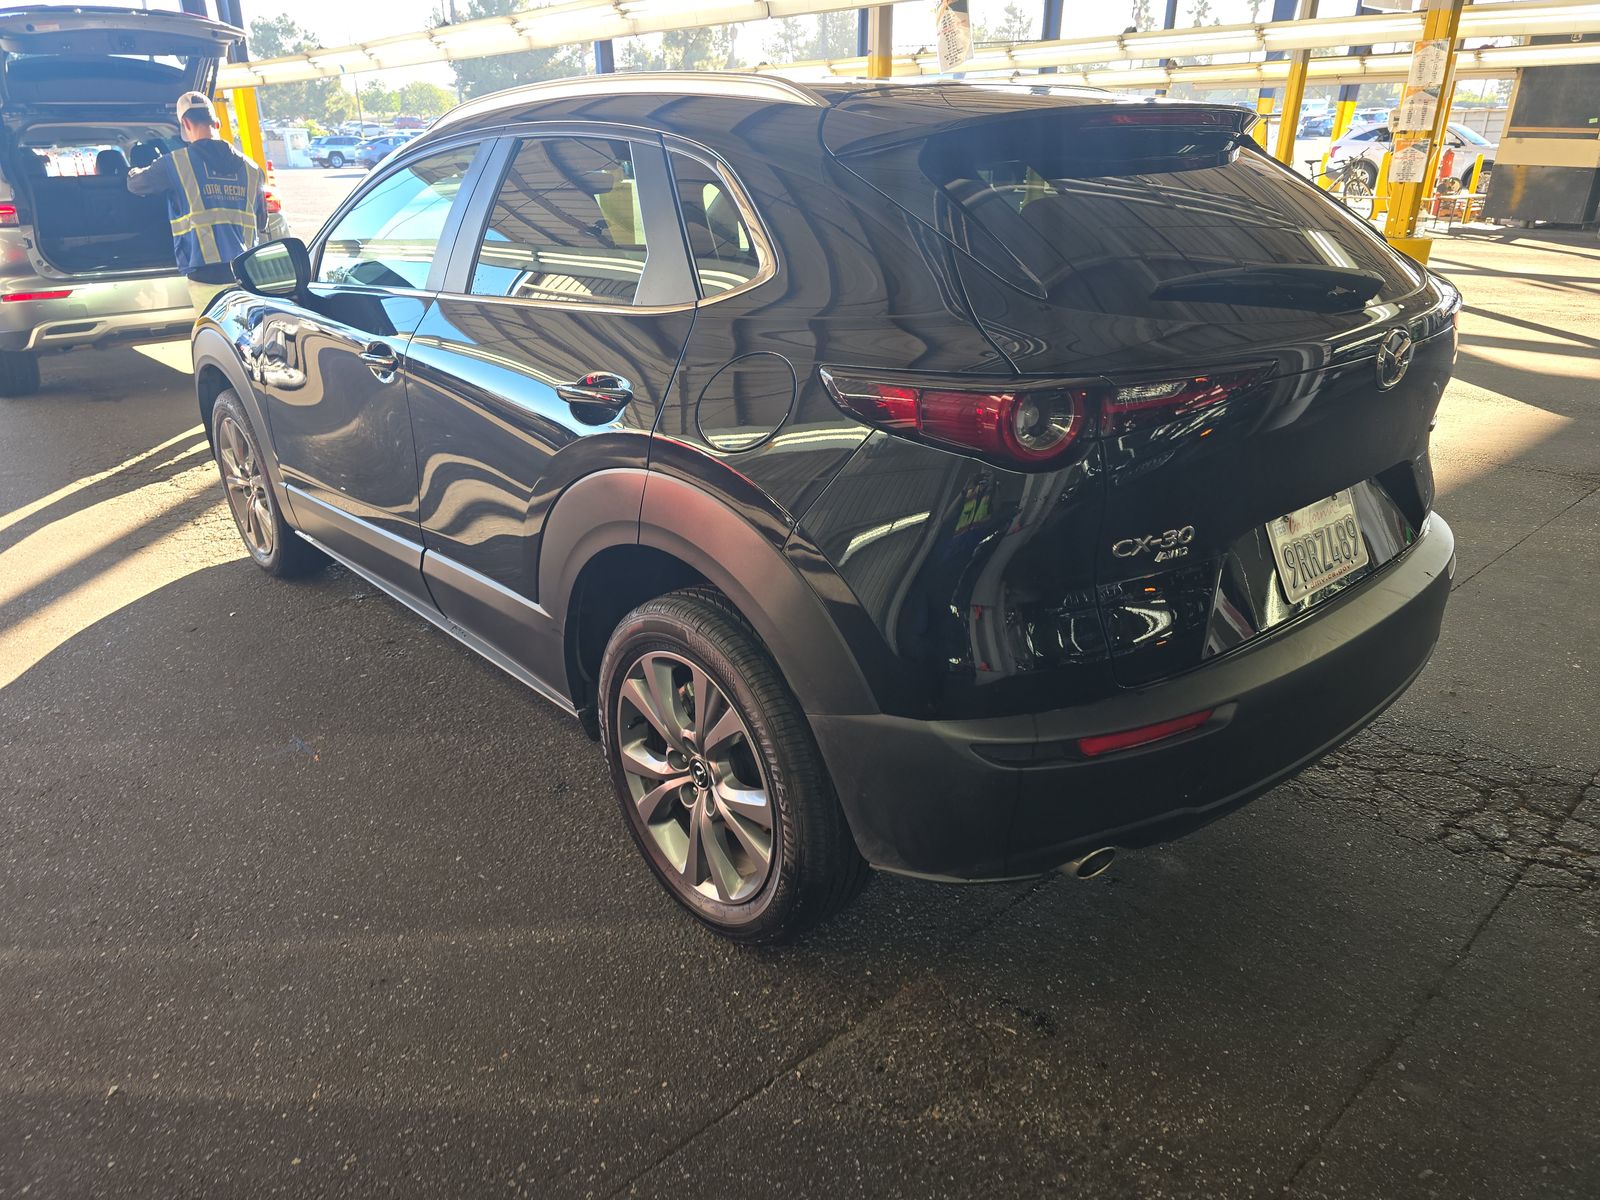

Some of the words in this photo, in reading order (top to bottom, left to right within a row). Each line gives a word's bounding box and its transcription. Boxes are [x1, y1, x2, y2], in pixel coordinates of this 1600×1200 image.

[223, 184, 245, 197] RECON
[1112, 525, 1195, 558] CX-30
[1154, 546, 1188, 562] AWD
[1283, 515, 1358, 589] 9RRZ489
[1310, 564, 1351, 589] dmv.ca.gov
[747, 710, 796, 873] BRIDGESTONE
